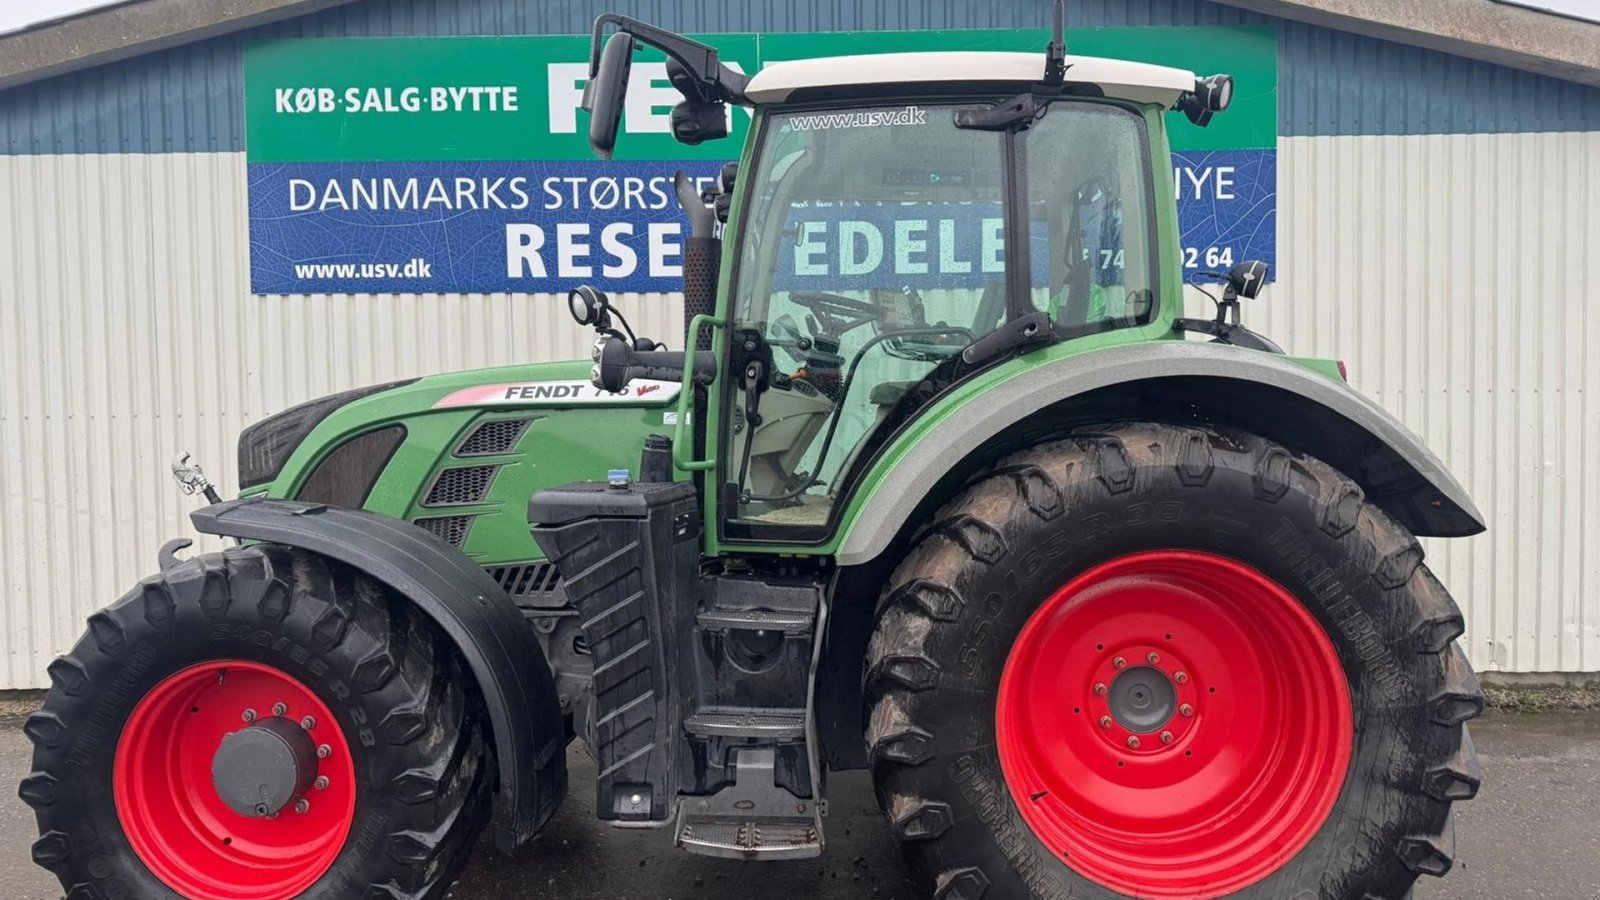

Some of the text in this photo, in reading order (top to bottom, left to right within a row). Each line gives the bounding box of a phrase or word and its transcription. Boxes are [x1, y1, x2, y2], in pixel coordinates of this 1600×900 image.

[789, 105, 926, 131] www.usv.dk
[289, 177, 529, 212] DANMARKS
[1205, 247, 1233, 268] 64
[294, 260, 432, 279] www.usv.dk
[505, 385, 584, 399] FENDT
[1267, 515, 1414, 702] TRELLEBORG
